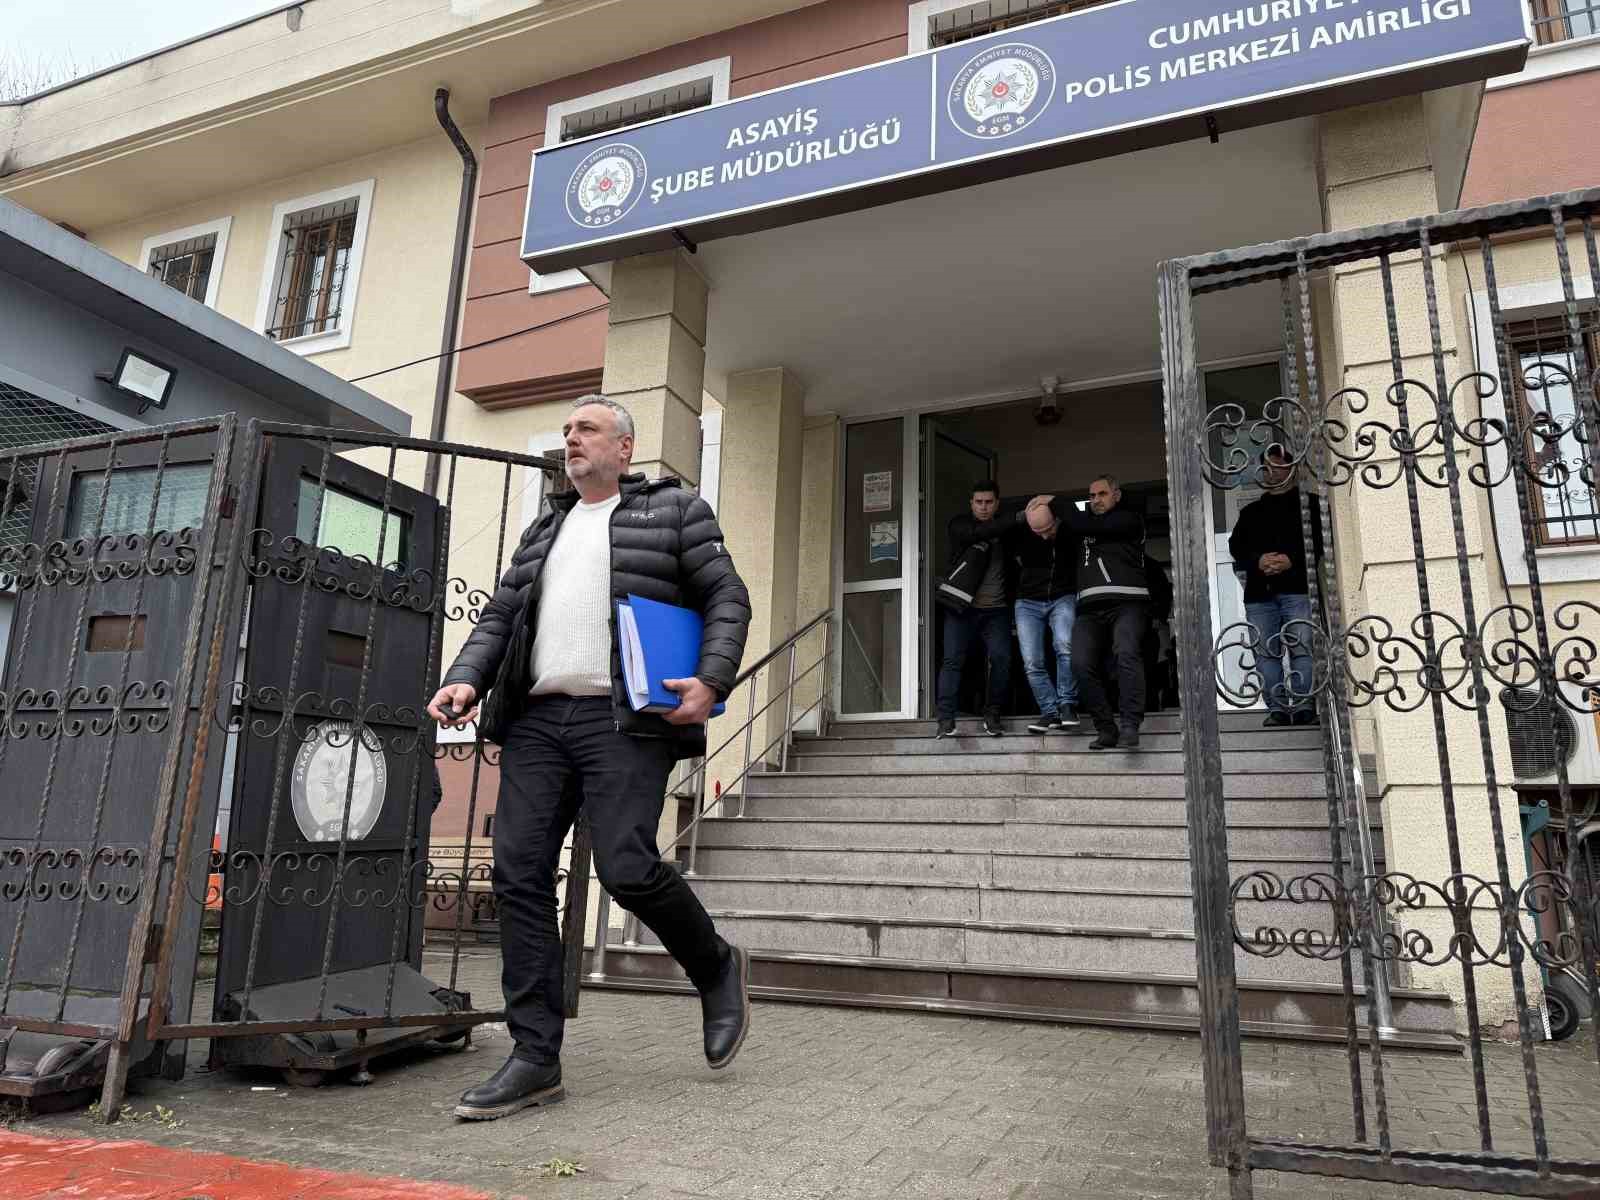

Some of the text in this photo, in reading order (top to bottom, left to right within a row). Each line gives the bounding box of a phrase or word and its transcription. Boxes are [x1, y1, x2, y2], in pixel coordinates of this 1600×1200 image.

[1064, 65, 1152, 104] POLİS
[1159, 27, 1301, 82] MERKEZİ
[650, 117, 902, 205] ŞUBE MÜDÜRLÜĞÜ
[726, 107, 819, 150] ASAYİŞ
